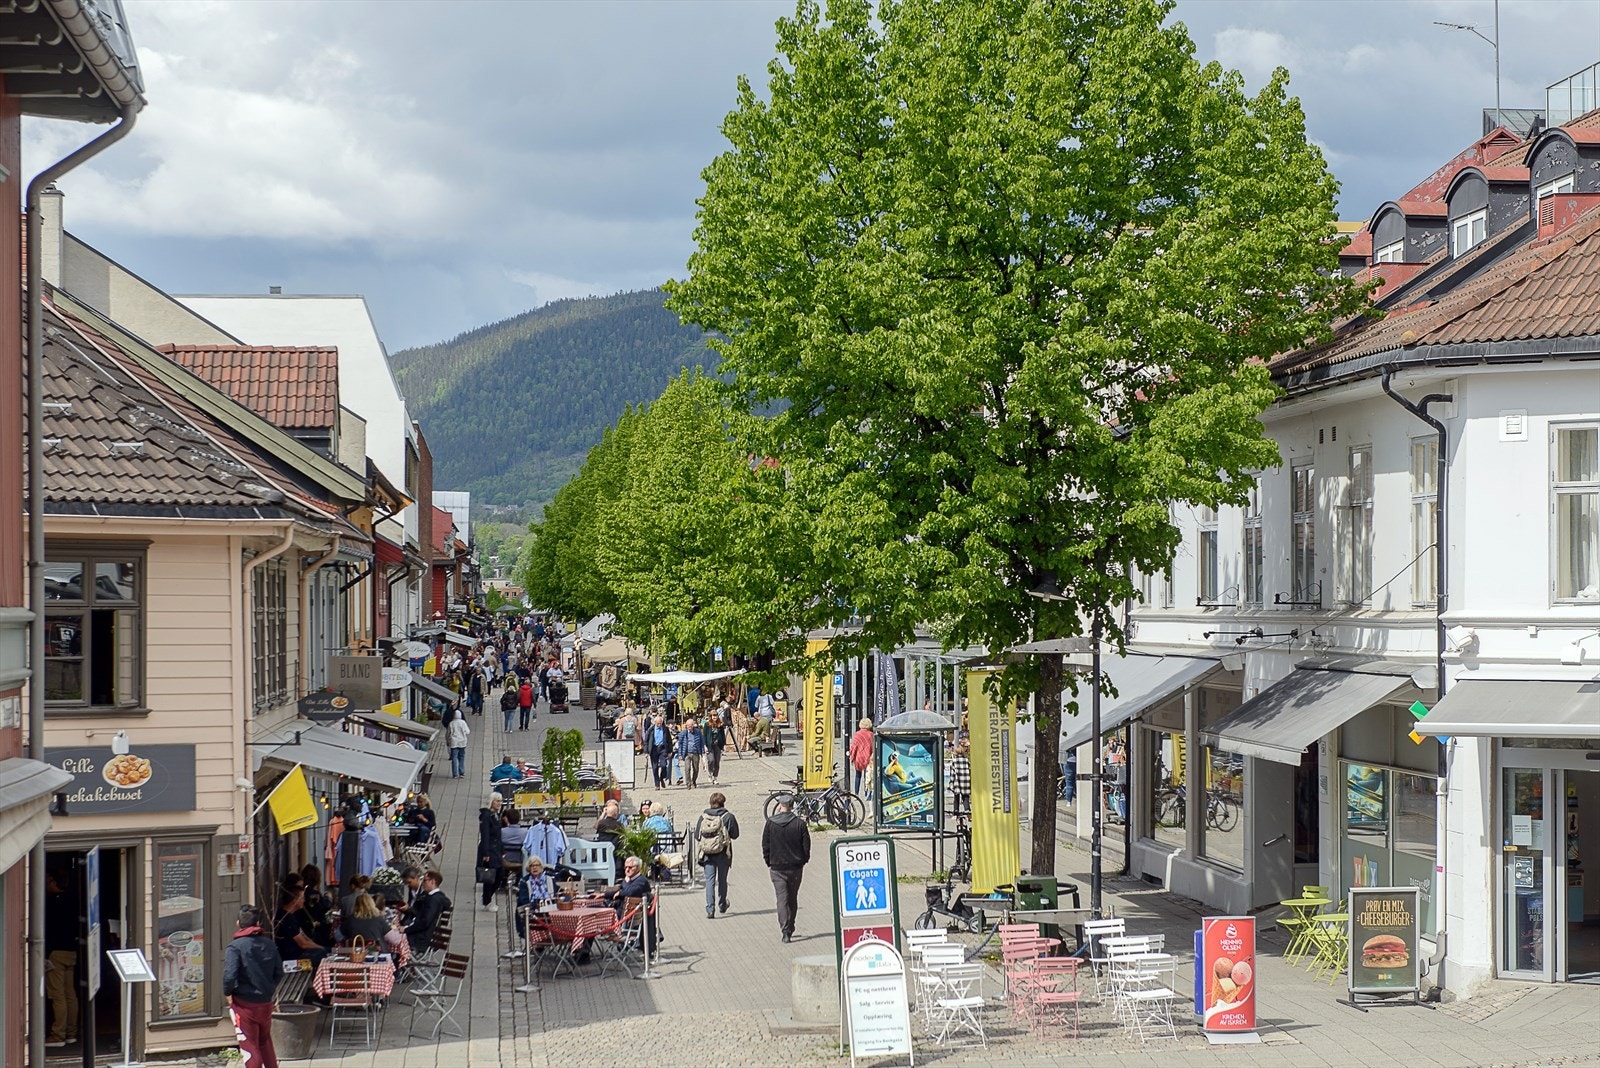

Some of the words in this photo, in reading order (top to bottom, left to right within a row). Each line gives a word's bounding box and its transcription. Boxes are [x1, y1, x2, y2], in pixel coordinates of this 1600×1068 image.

[340, 663, 370, 679] BLANC
[62, 758, 94, 773] Lille
[989, 703, 1002, 814] TERATURFESTIVAL
[846, 850, 880, 862] Sone
[850, 869, 878, 880] Gågate
[1355, 863, 1376, 887] MIX
[1366, 900, 1382, 912] PRØV
[1382, 900, 1390, 912] EN
[1392, 900, 1404, 912] MIX
[1360, 912, 1410, 926] CHEESEBURGER
[1529, 914, 1543, 922] PØLS
